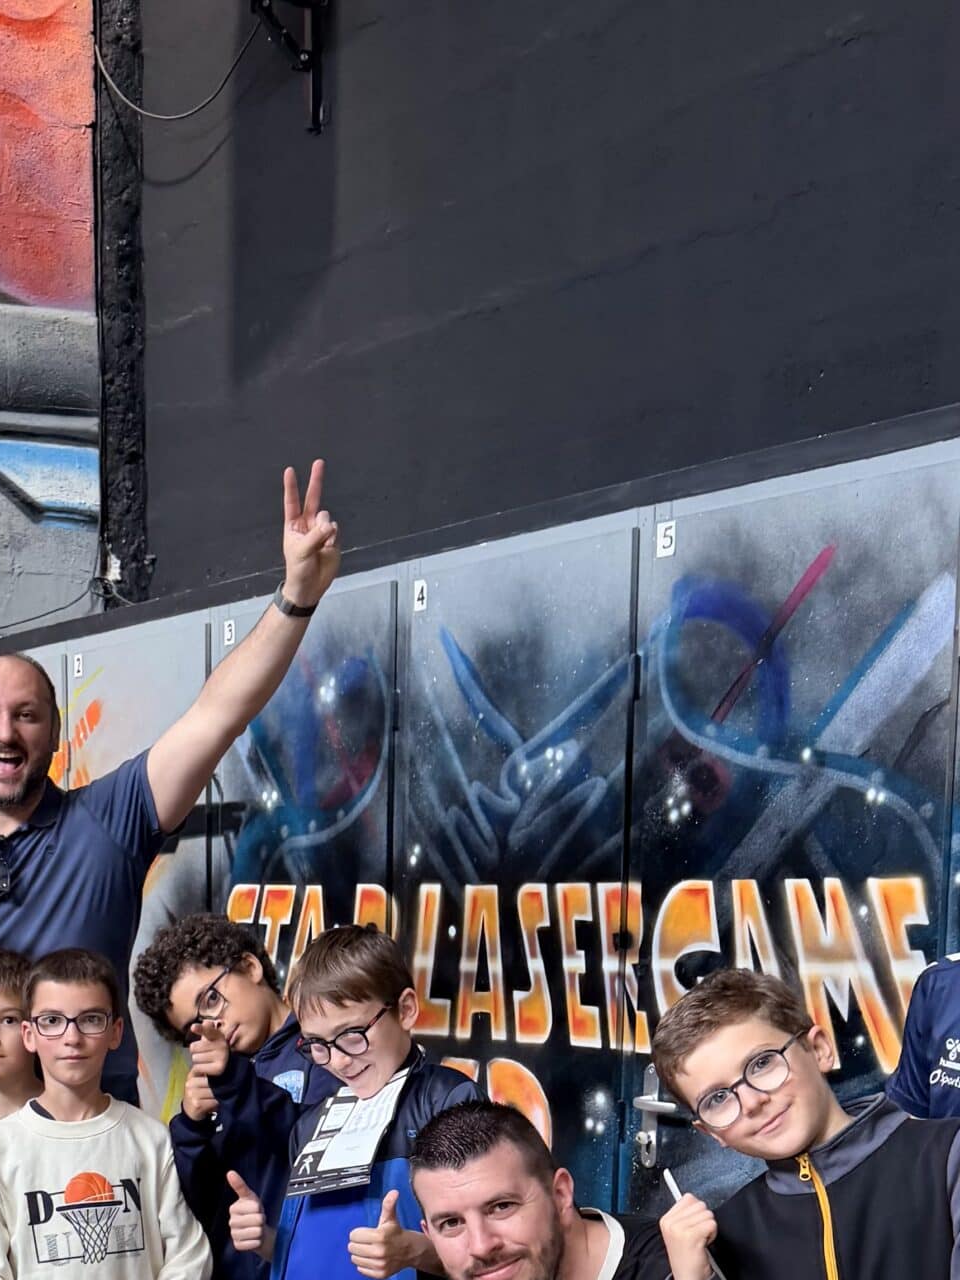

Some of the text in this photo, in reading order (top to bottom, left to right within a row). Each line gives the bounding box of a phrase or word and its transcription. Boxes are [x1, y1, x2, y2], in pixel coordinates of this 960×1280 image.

[662, 525, 673, 549] 5
[415, 587, 425, 606] 4
[225, 625, 233, 643] 3
[74, 656, 82, 674] 2
[411, 882, 652, 1055] LASER
